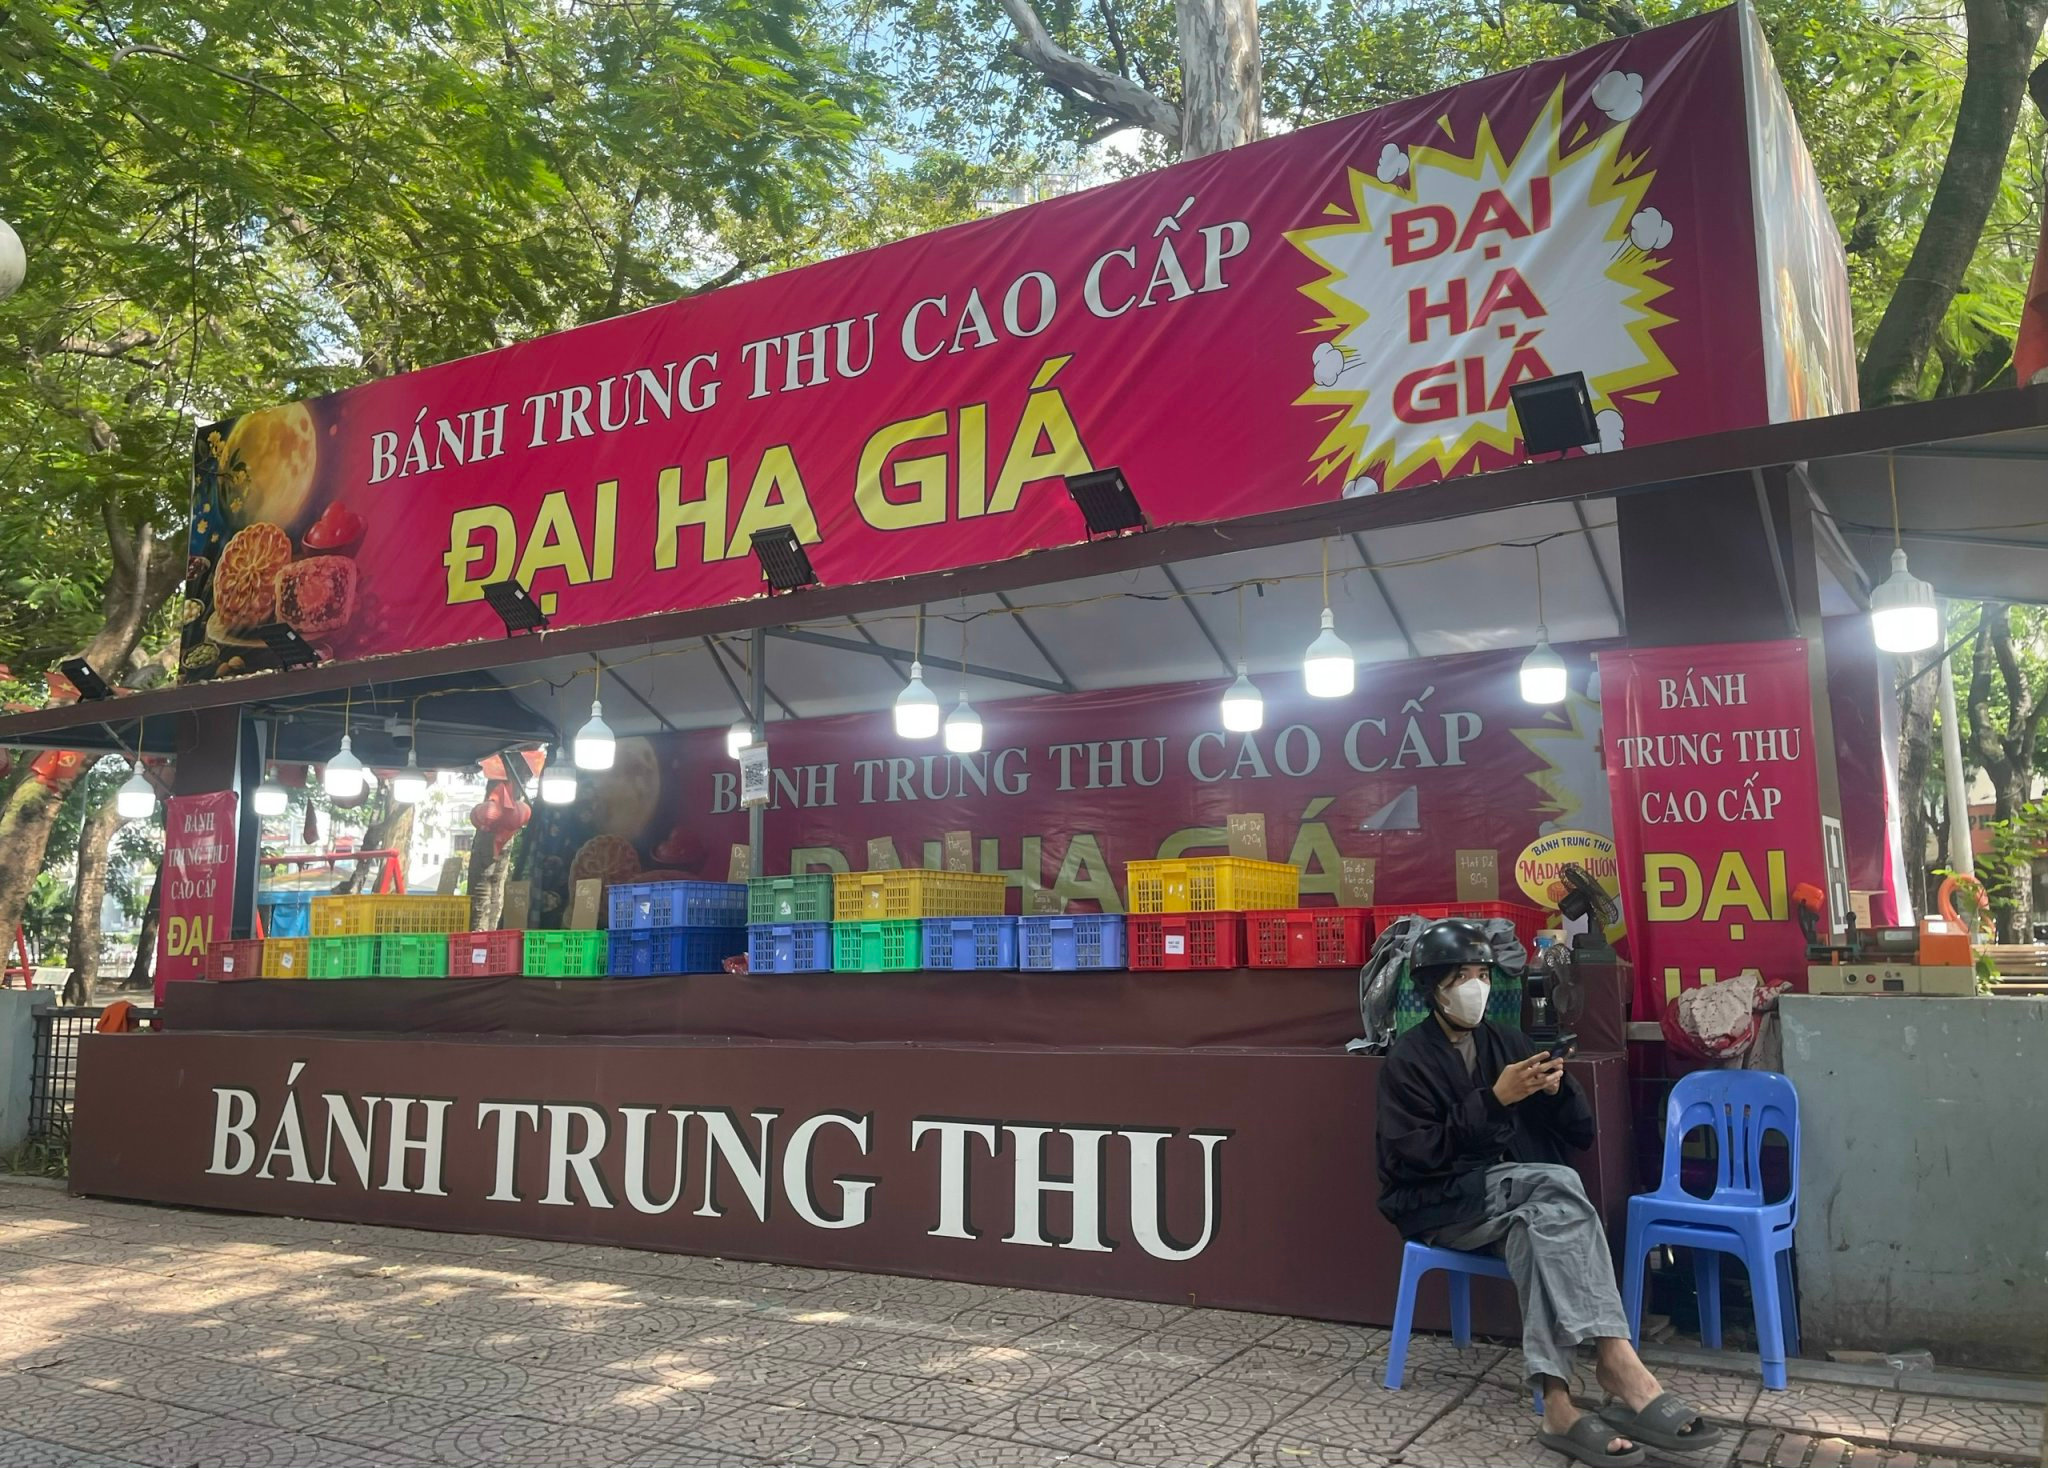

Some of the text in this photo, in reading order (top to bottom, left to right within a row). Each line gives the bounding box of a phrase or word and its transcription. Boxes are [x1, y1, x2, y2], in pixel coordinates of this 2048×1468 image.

[1385, 175, 1553, 267] ĐẠI
[1407, 268, 1547, 345] HẠ
[368, 195, 1252, 485] BÁNH TRUNG THU CAO CẤP
[1392, 328, 1556, 424] GIÁ
[442, 479, 620, 616] ĐẠI
[852, 353, 1098, 532] GIÁ
[1658, 667, 1748, 710] BÁNH
[710, 685, 1484, 815] BNH TRUNG THU CAO CẤP
[1617, 727, 1801, 769] TRUNG THU
[184, 808, 215, 833] BÁNH
[1641, 771, 1783, 825] CAO CẤP
[168, 844, 229, 867] TRUNG THU
[1561, 836, 1591, 848] TRUNG
[1594, 839, 1613, 853] THU
[171, 869, 217, 900] CAO CẤP
[1519, 860, 1579, 886] MADA
[1641, 848, 1790, 940] ĐẠI
[167, 915, 213, 966] ĐẠI
[205, 1061, 1229, 1262] BÁNH TRUNG THU
